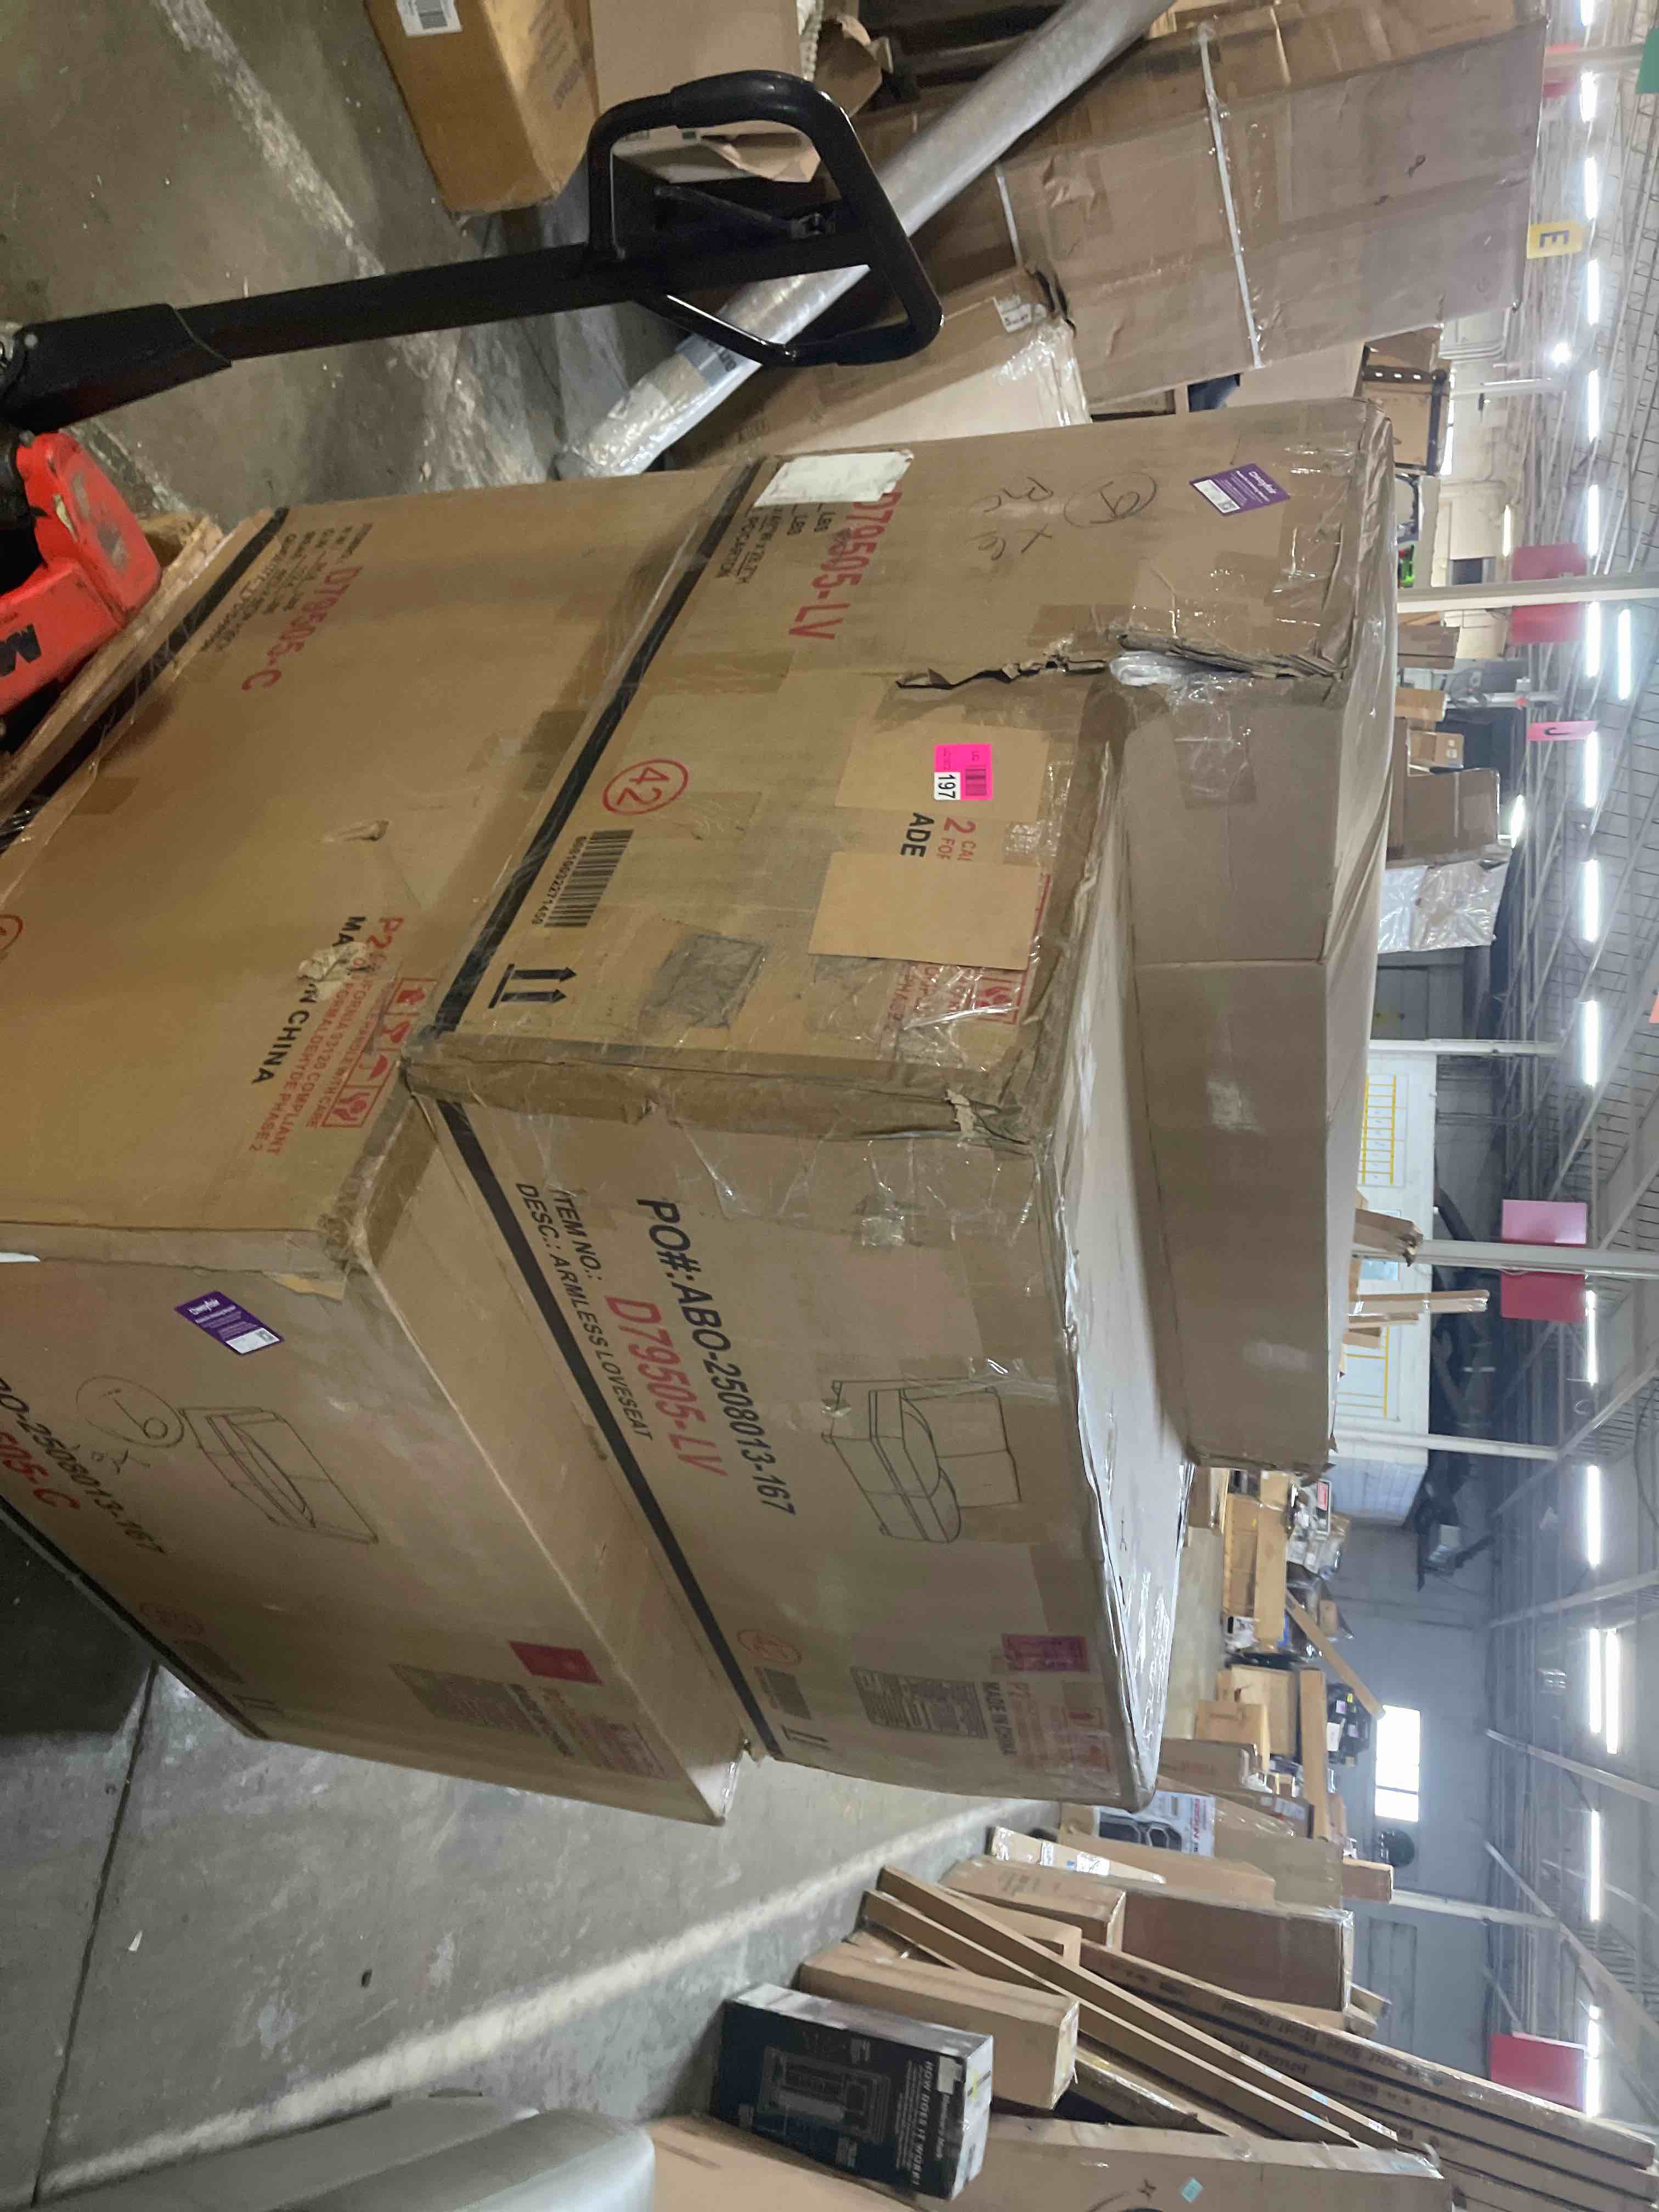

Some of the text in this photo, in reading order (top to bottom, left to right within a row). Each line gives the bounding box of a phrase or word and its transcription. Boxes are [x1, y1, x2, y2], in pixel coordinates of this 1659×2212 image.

[1539, 229, 1570, 247] E
[1545, 727, 1571, 736] J
[617, 767, 670, 806] 42
[938, 774, 956, 799] 197
[367, 917, 405, 949] P2
[251, 1010, 309, 1085] CHINA
[283, 983, 356, 1090] FORMALDEHYDE
[255, 1093, 294, 1141] PHASE
[268, 1073, 321, 1156] COMPLIANT
[248, 1143, 265, 1152] 2
[552, 1189, 602, 1280] ITEM NO.:
[515, 1183, 653, 1440] DESC.: ARMLESS LOVESEAT
[636, 1199, 796, 1515] PO#:ABO-2508013-167
[605, 1295, 729, 1477] D79505-LV
[922, 2061, 935, 2091] HOW
[918, 2094, 931, 2125] DOES
[917, 2128, 926, 2141] IT
